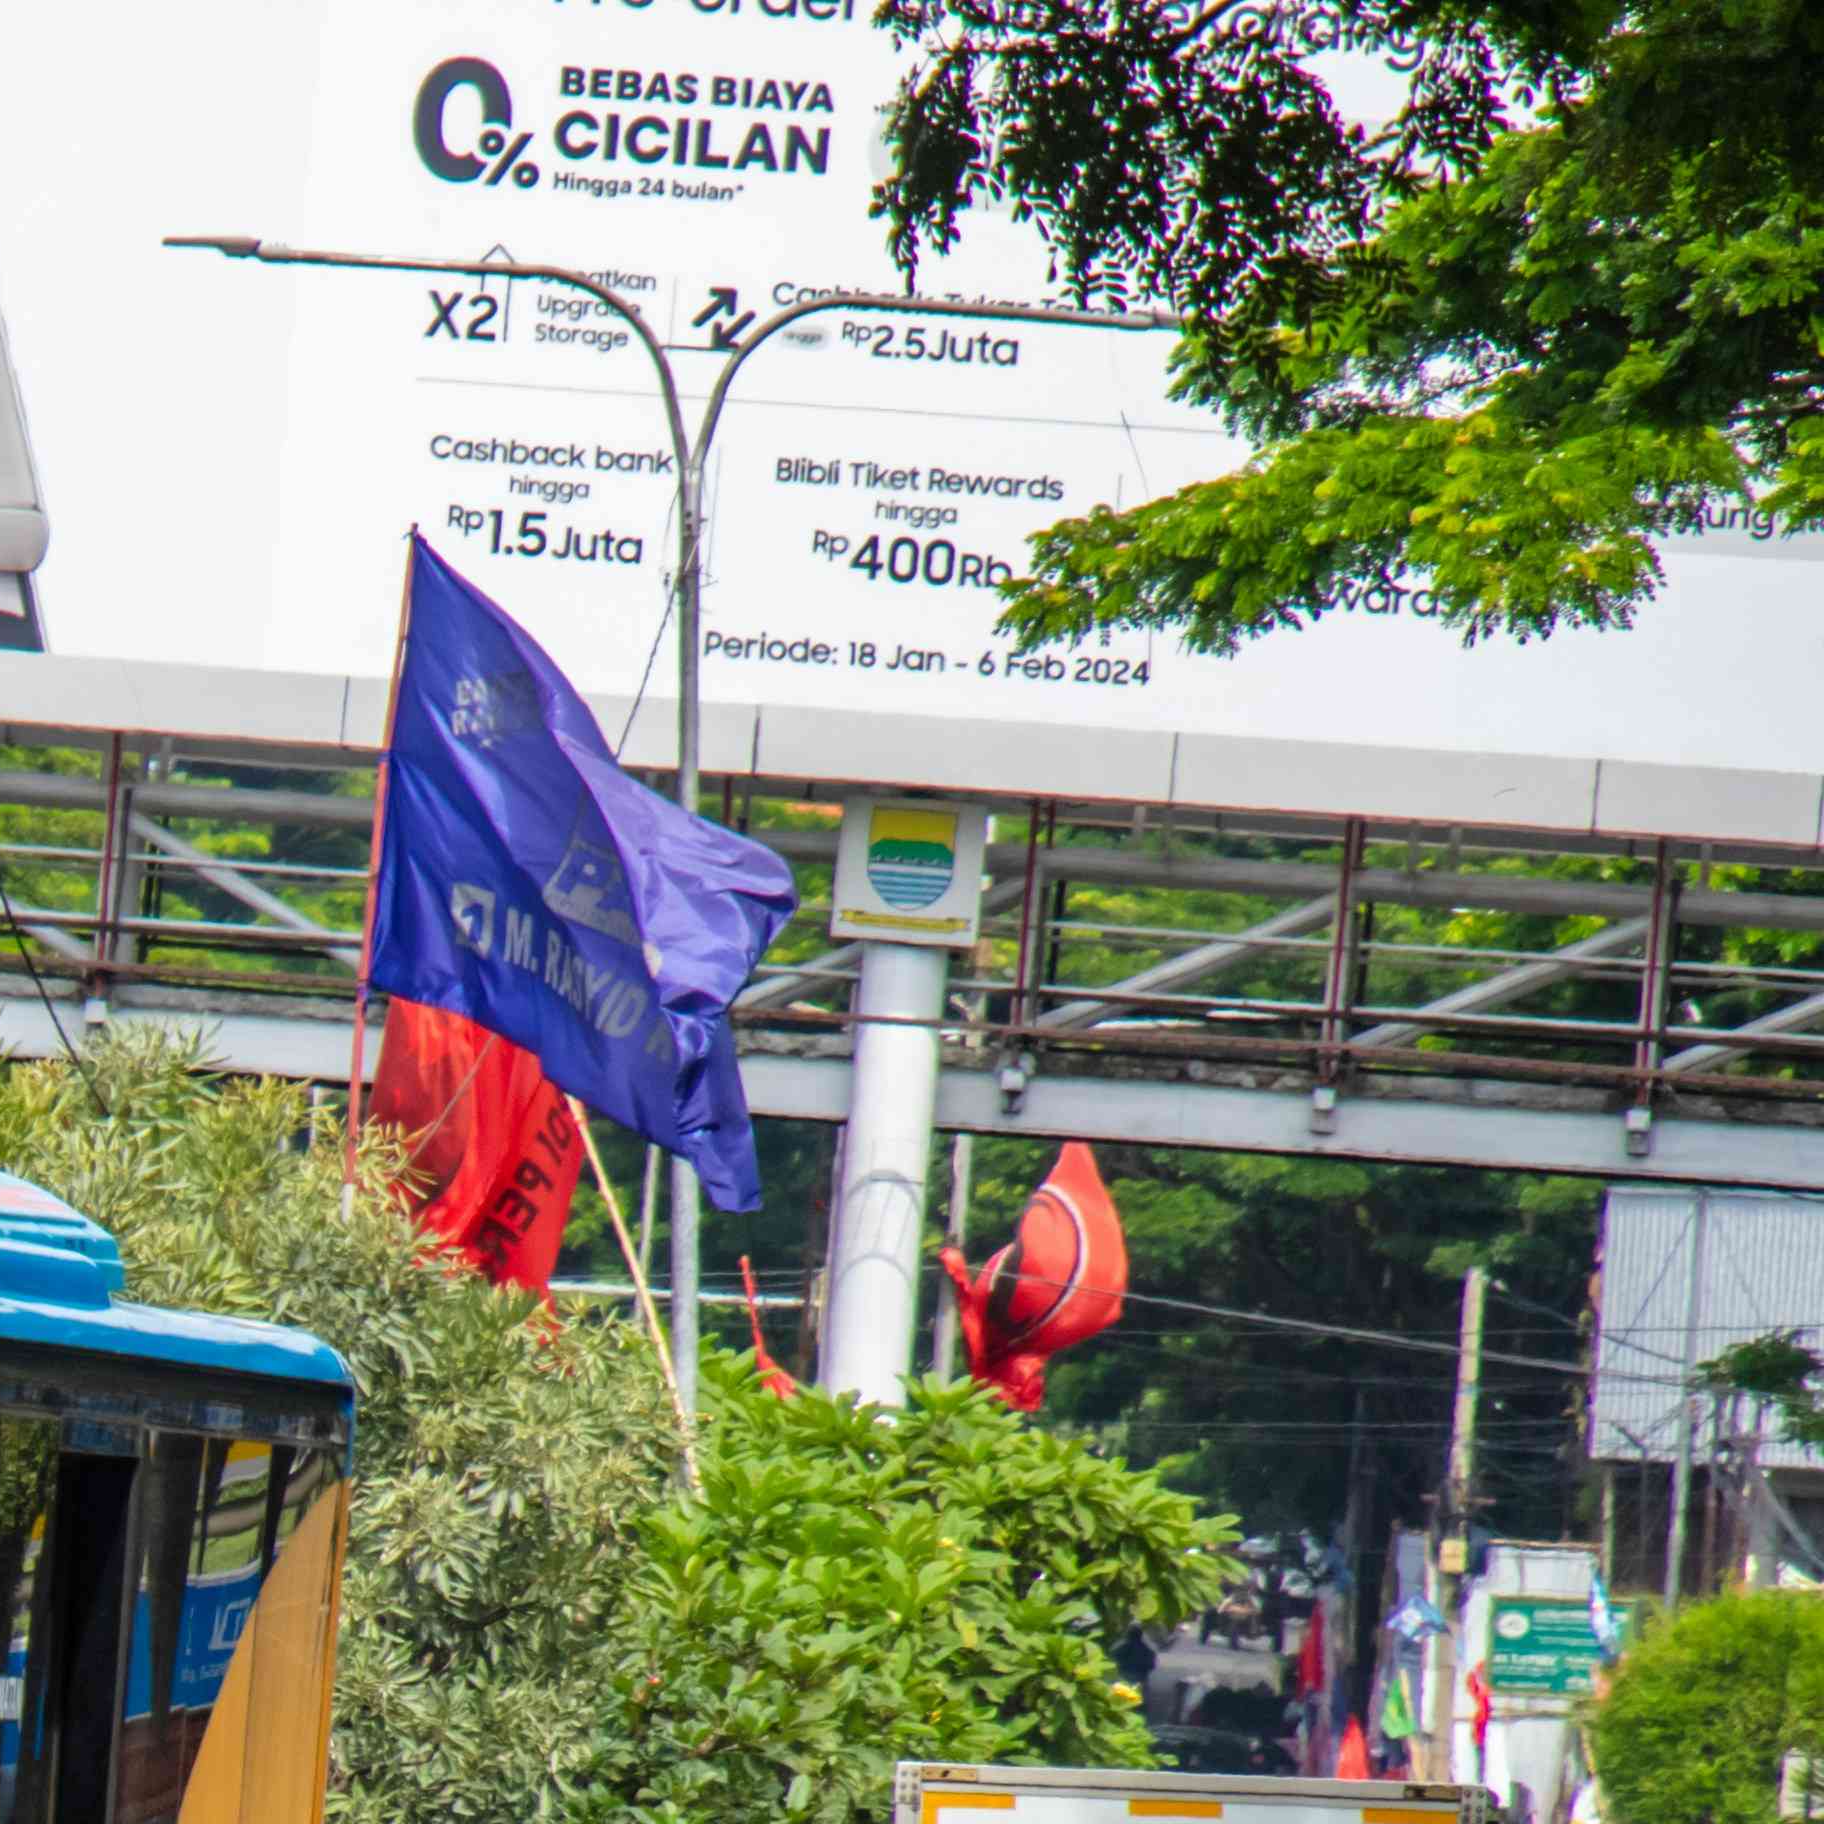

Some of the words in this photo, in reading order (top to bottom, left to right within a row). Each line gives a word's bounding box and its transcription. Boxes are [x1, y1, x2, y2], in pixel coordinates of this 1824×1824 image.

[560, 66, 698, 104] BEBAS
[710, 76, 835, 112] BIAYA
[412, 55, 541, 190] 0%
[554, 110, 832, 174] CICILAN
[553, 172, 632, 198] Hingga
[639, 178, 665, 196] 24
[425, 290, 498, 341] X2
[534, 322, 630, 352] Storage
[429, 434, 586, 469] Cashback
[595, 446, 675, 475] bank
[509, 475, 591, 504] hingga
[776, 457, 841, 488] Blibli
[849, 462, 921, 492] Tiket
[928, 468, 1064, 501] Rewards
[875, 500, 958, 529] hingga
[704, 631, 838, 666] Periode:
[849, 641, 876, 668] 18
[886, 646, 946, 674] Jan
[978, 651, 996, 677] 6
[1005, 652, 1066, 682] Feb
[1074, 656, 1150, 687] 2024
